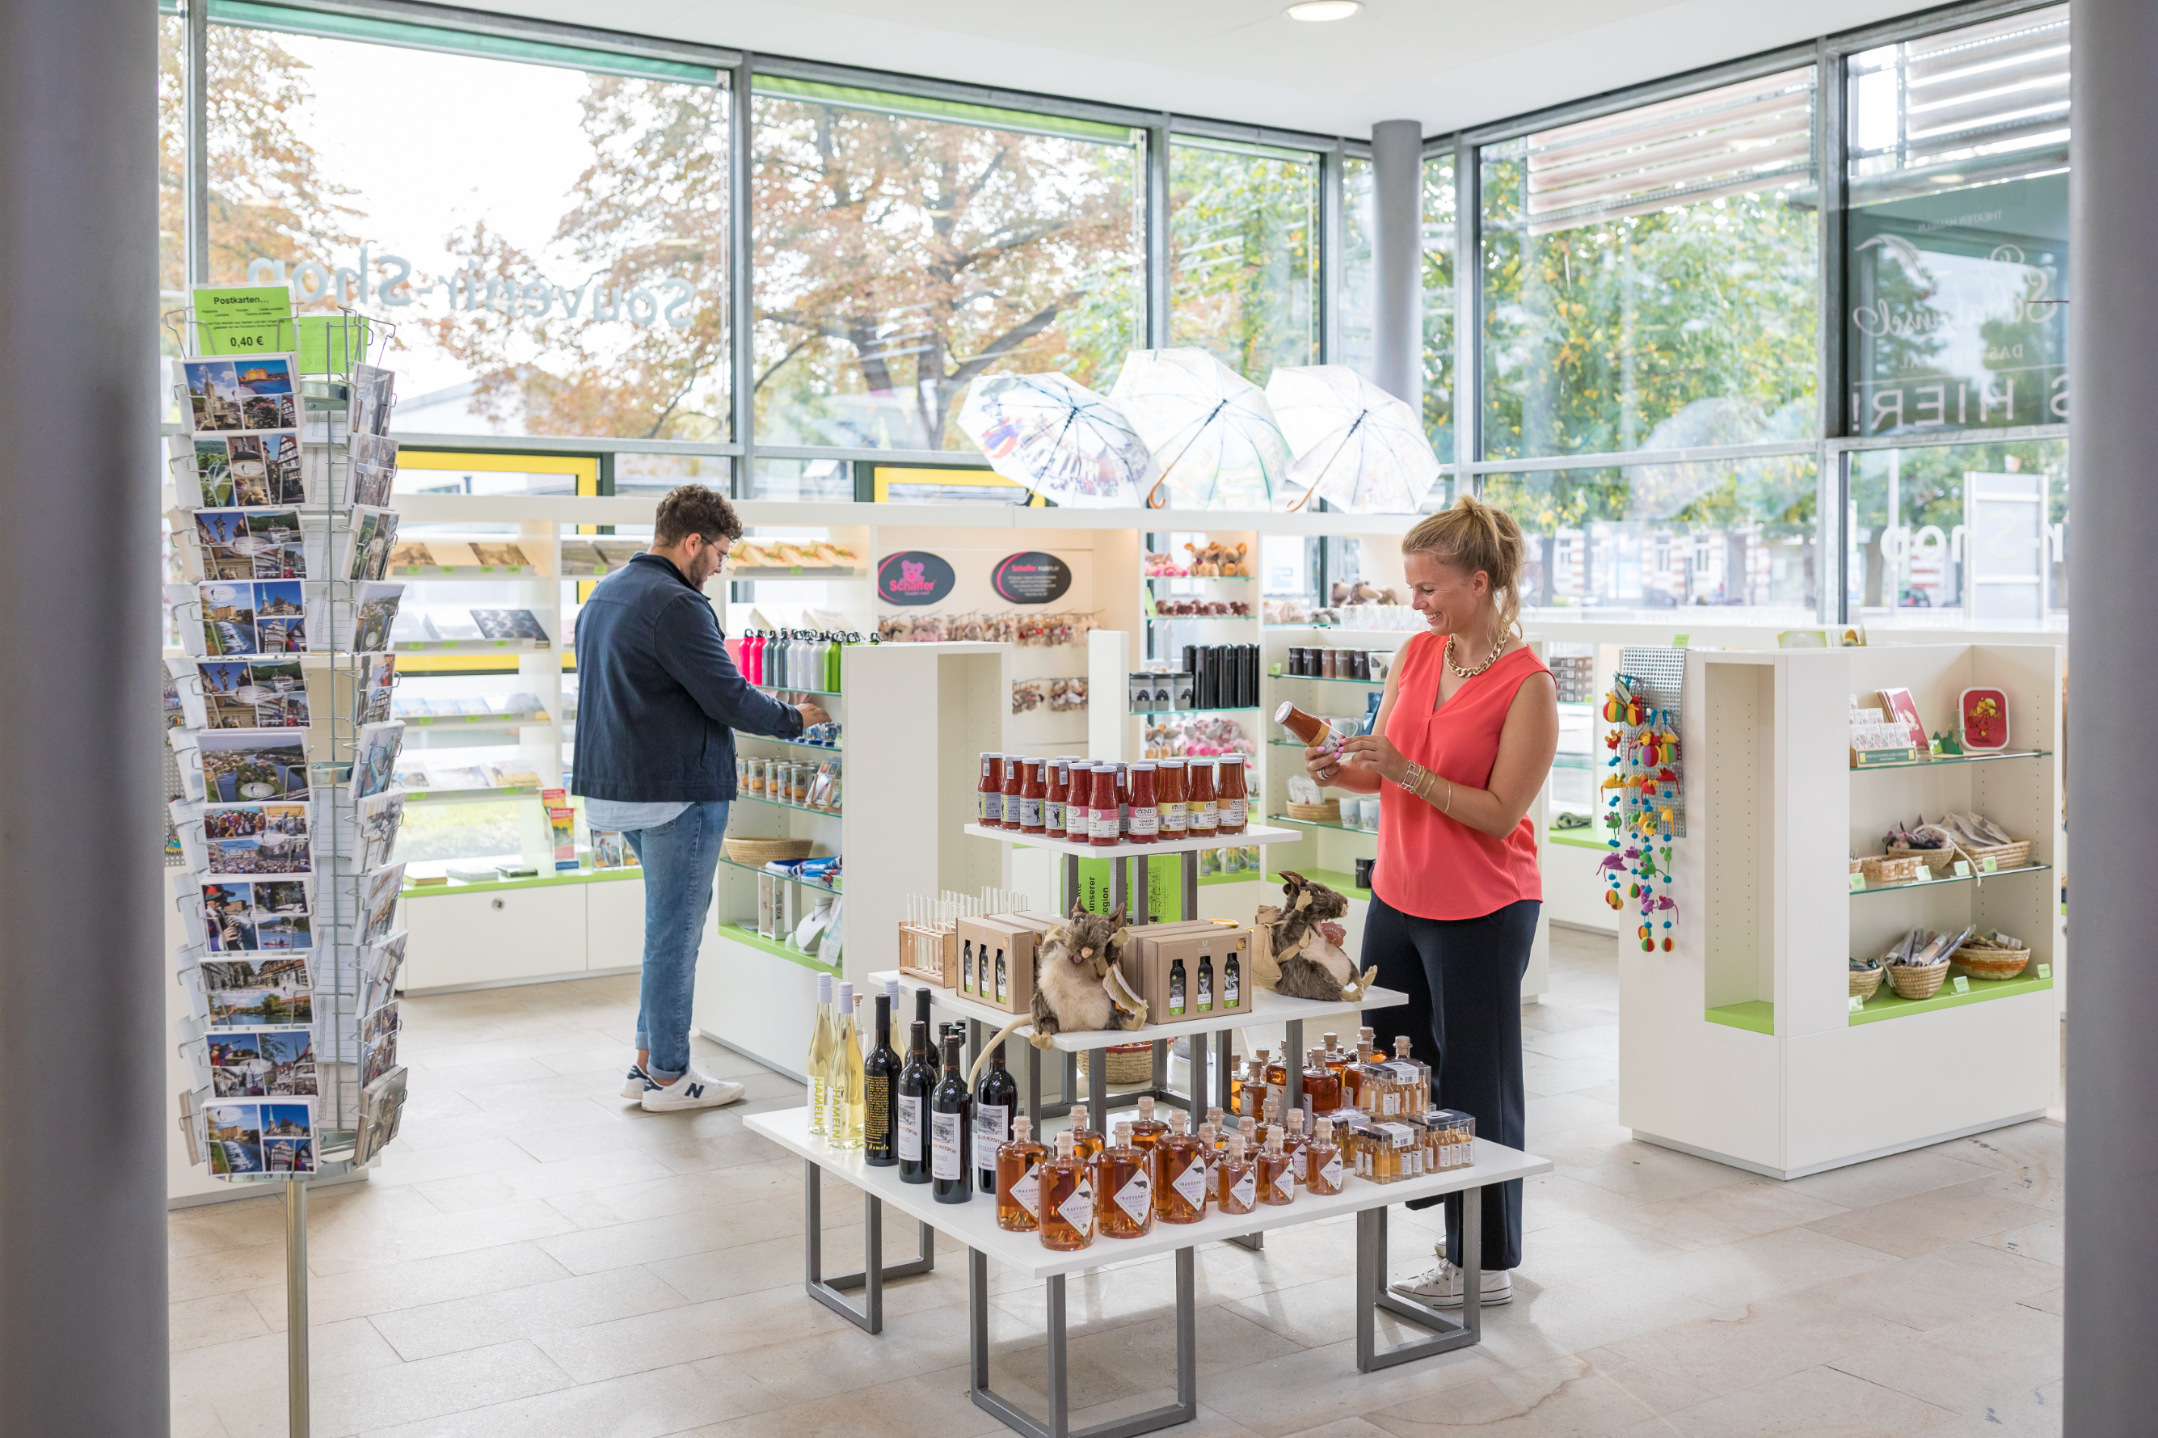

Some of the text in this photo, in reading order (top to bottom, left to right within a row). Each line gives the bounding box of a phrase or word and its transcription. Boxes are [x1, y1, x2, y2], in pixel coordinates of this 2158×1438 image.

[213, 296, 269, 305] Postkarten...
[230, 335, 264, 348] 0,40 €
[889, 579, 934, 592] Schaffer
[684, 1082, 705, 1099] N
[814, 1077, 824, 1126] HAMELN
[832, 1089, 841, 1139] HAMELN
